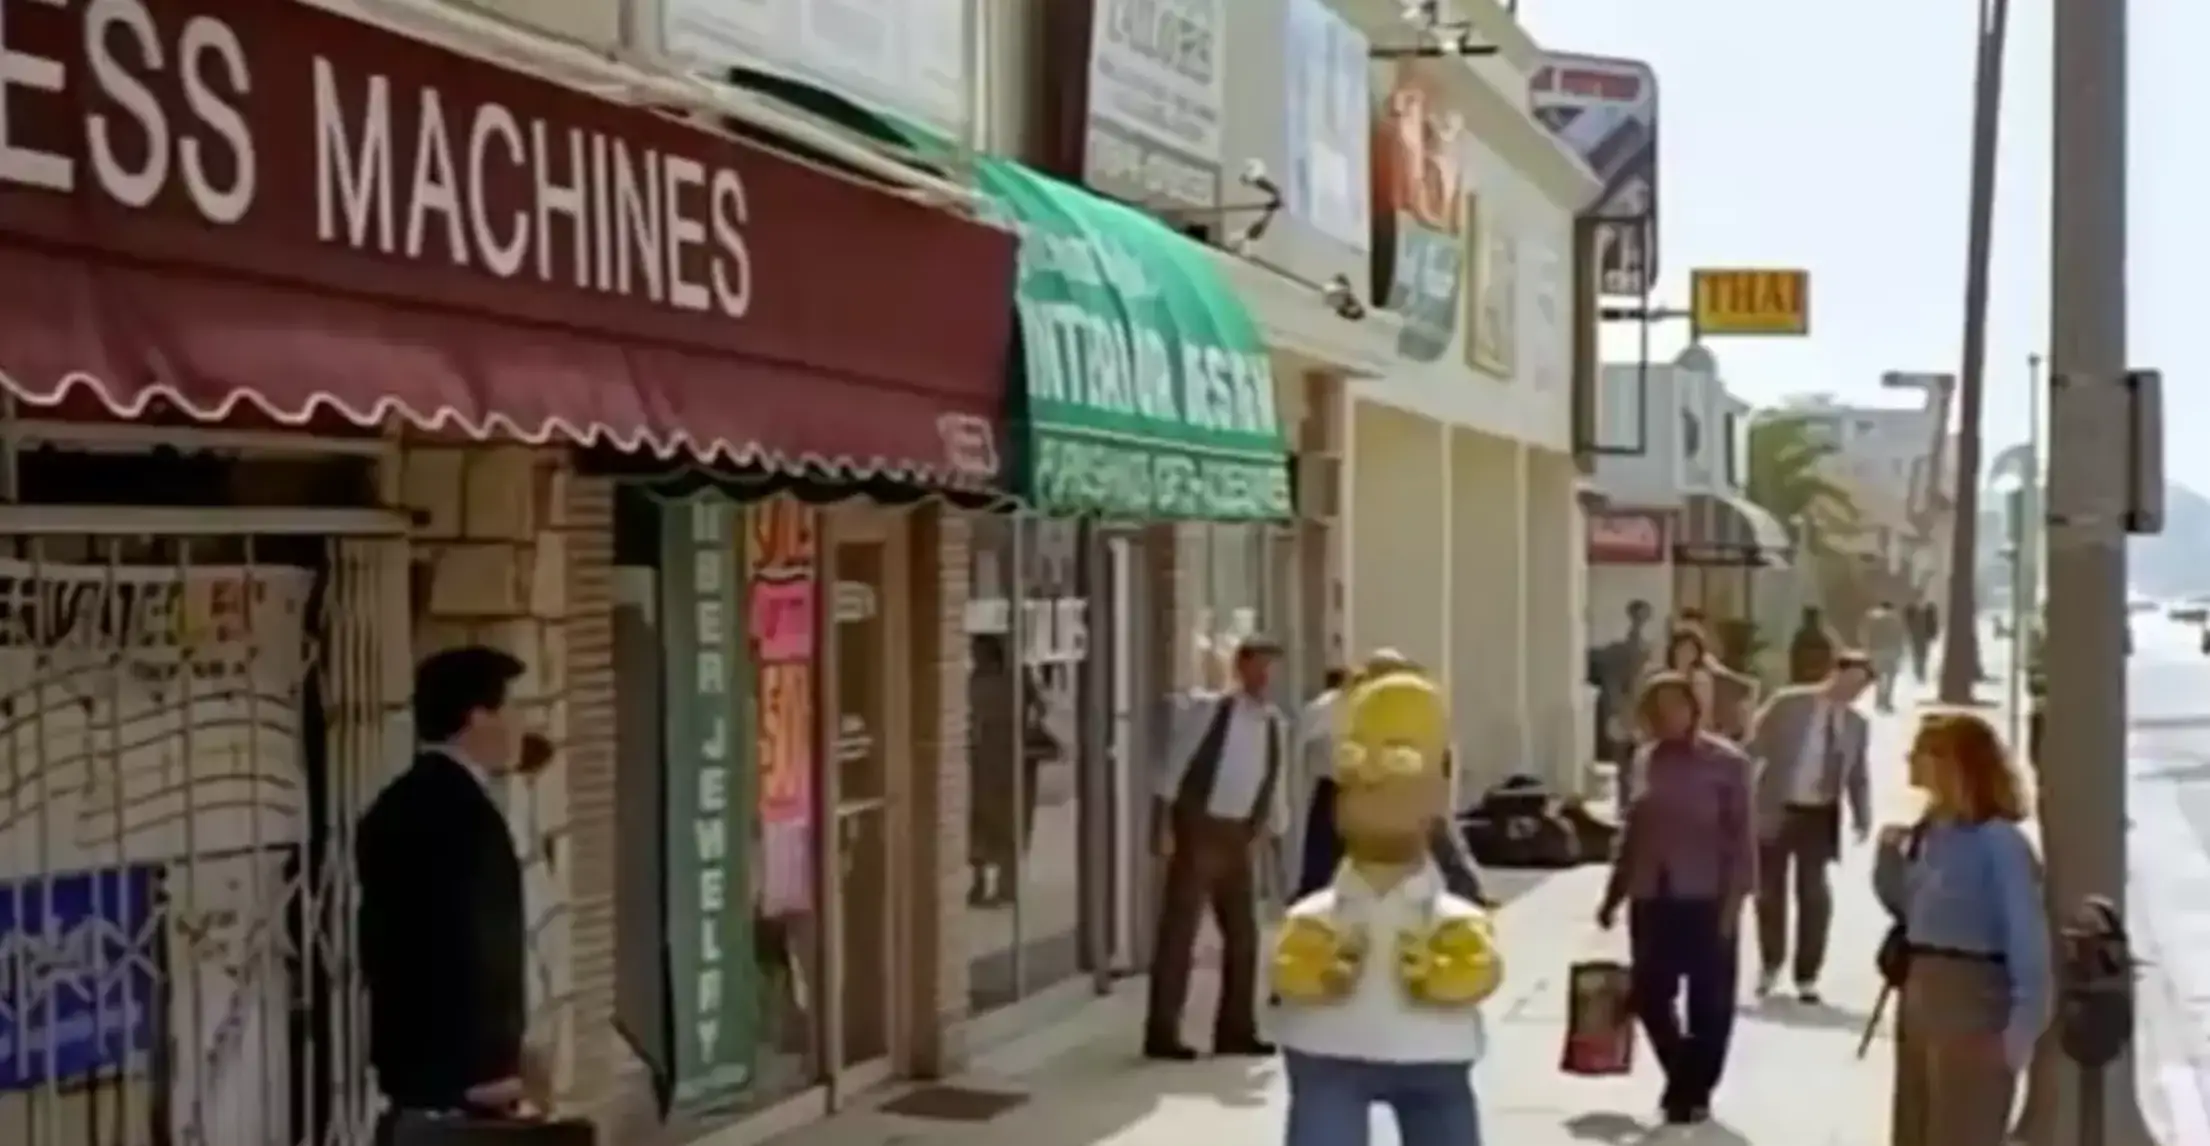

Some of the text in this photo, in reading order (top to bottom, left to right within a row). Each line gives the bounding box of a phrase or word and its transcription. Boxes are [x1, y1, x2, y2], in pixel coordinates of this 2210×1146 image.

[0, 0, 751, 318] ESS MACHINES
[1702, 271, 1801, 313] THAI
